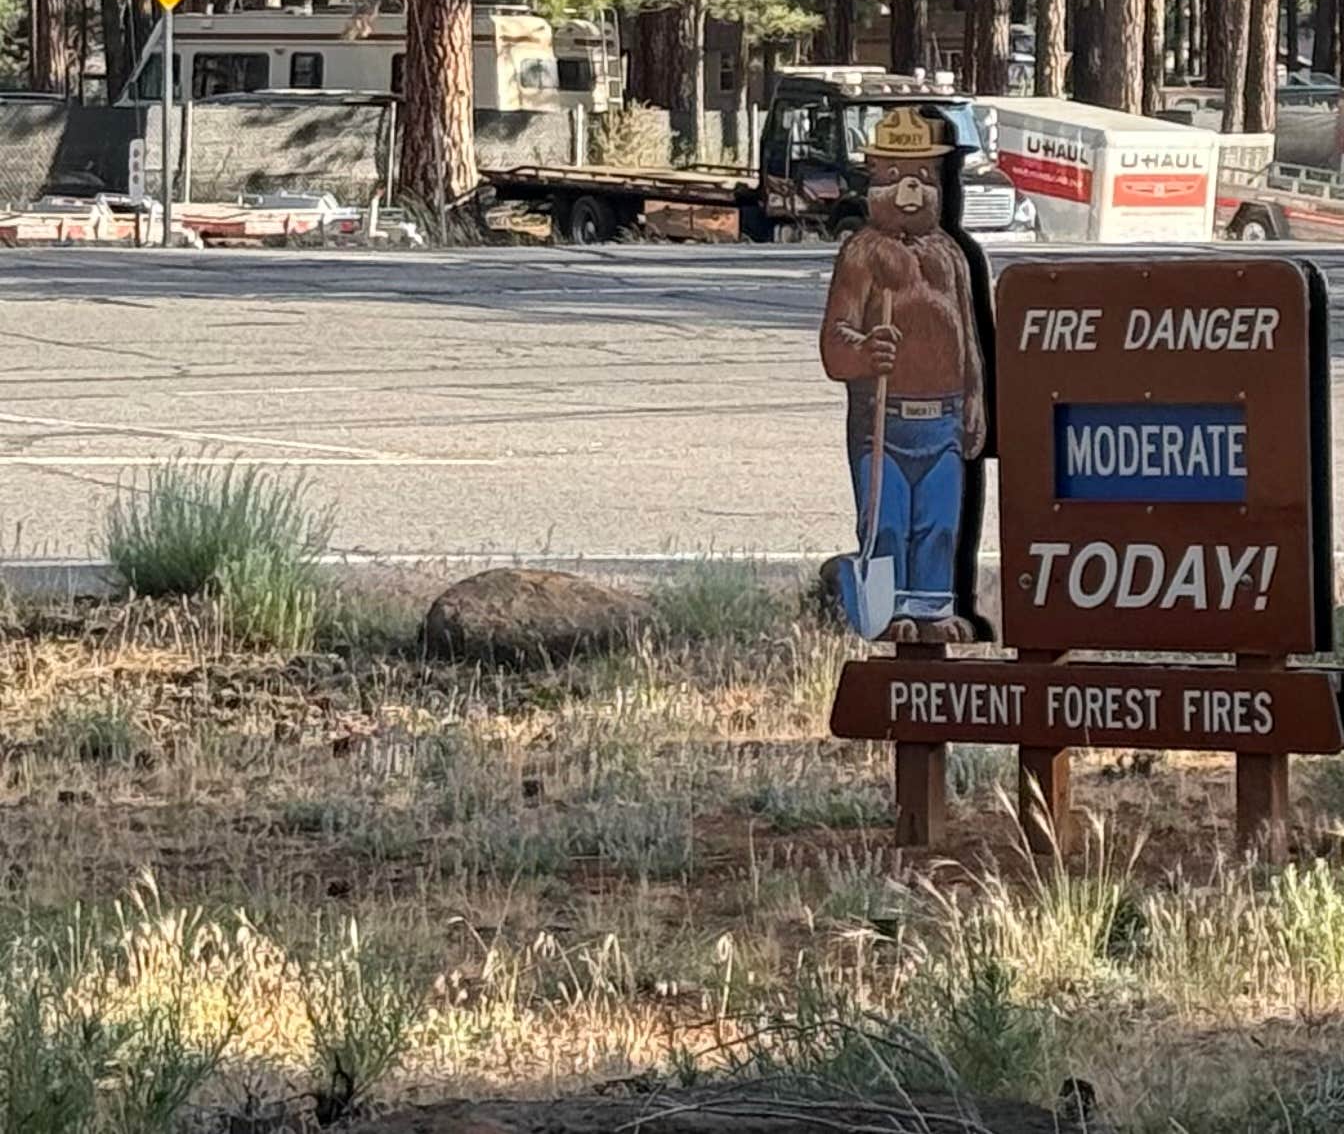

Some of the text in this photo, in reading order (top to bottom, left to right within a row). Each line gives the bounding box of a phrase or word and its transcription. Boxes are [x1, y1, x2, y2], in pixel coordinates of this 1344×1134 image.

[1019, 307, 1279, 351] FIRE DANGER
[1066, 424, 1248, 477] MODERATE
[1028, 540, 1279, 611] TODAY!
[890, 681, 1274, 735] PREVENT FOREST FIRES
